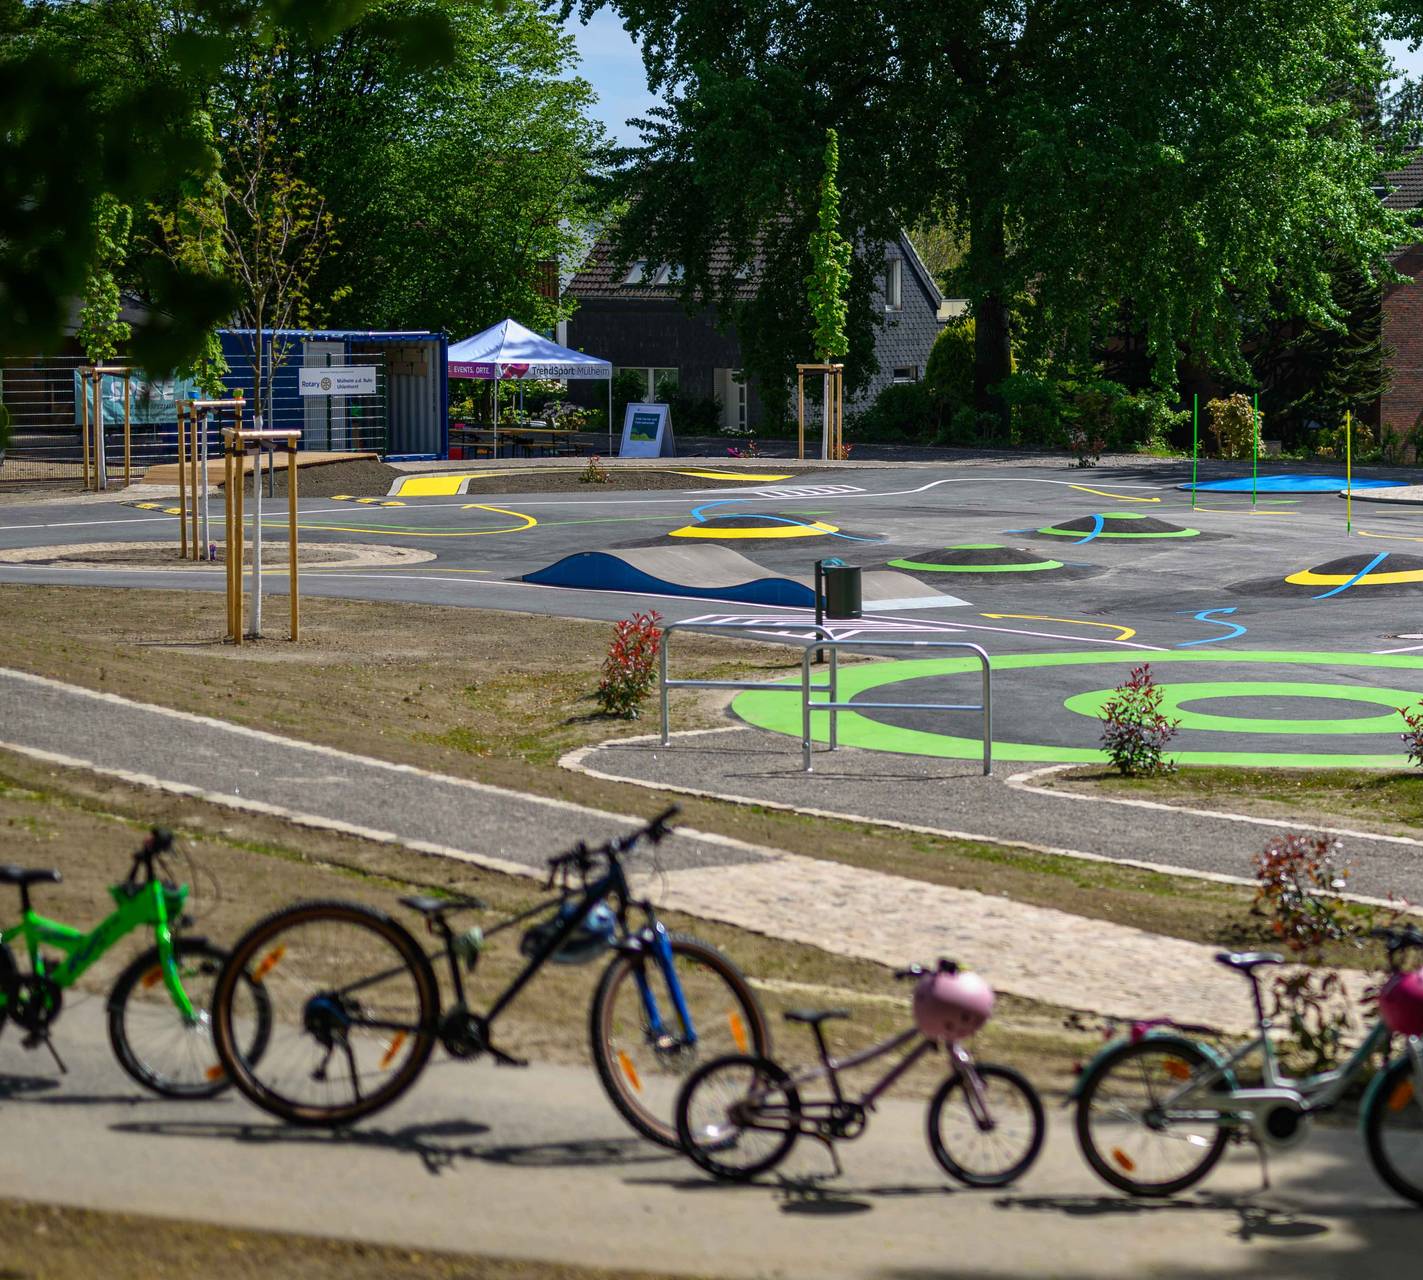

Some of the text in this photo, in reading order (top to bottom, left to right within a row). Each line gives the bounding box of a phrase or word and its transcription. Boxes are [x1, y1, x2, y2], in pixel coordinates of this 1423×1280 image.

[532, 366, 610, 378] TrendSport Mülheim
[301, 380, 320, 388] Rotary
